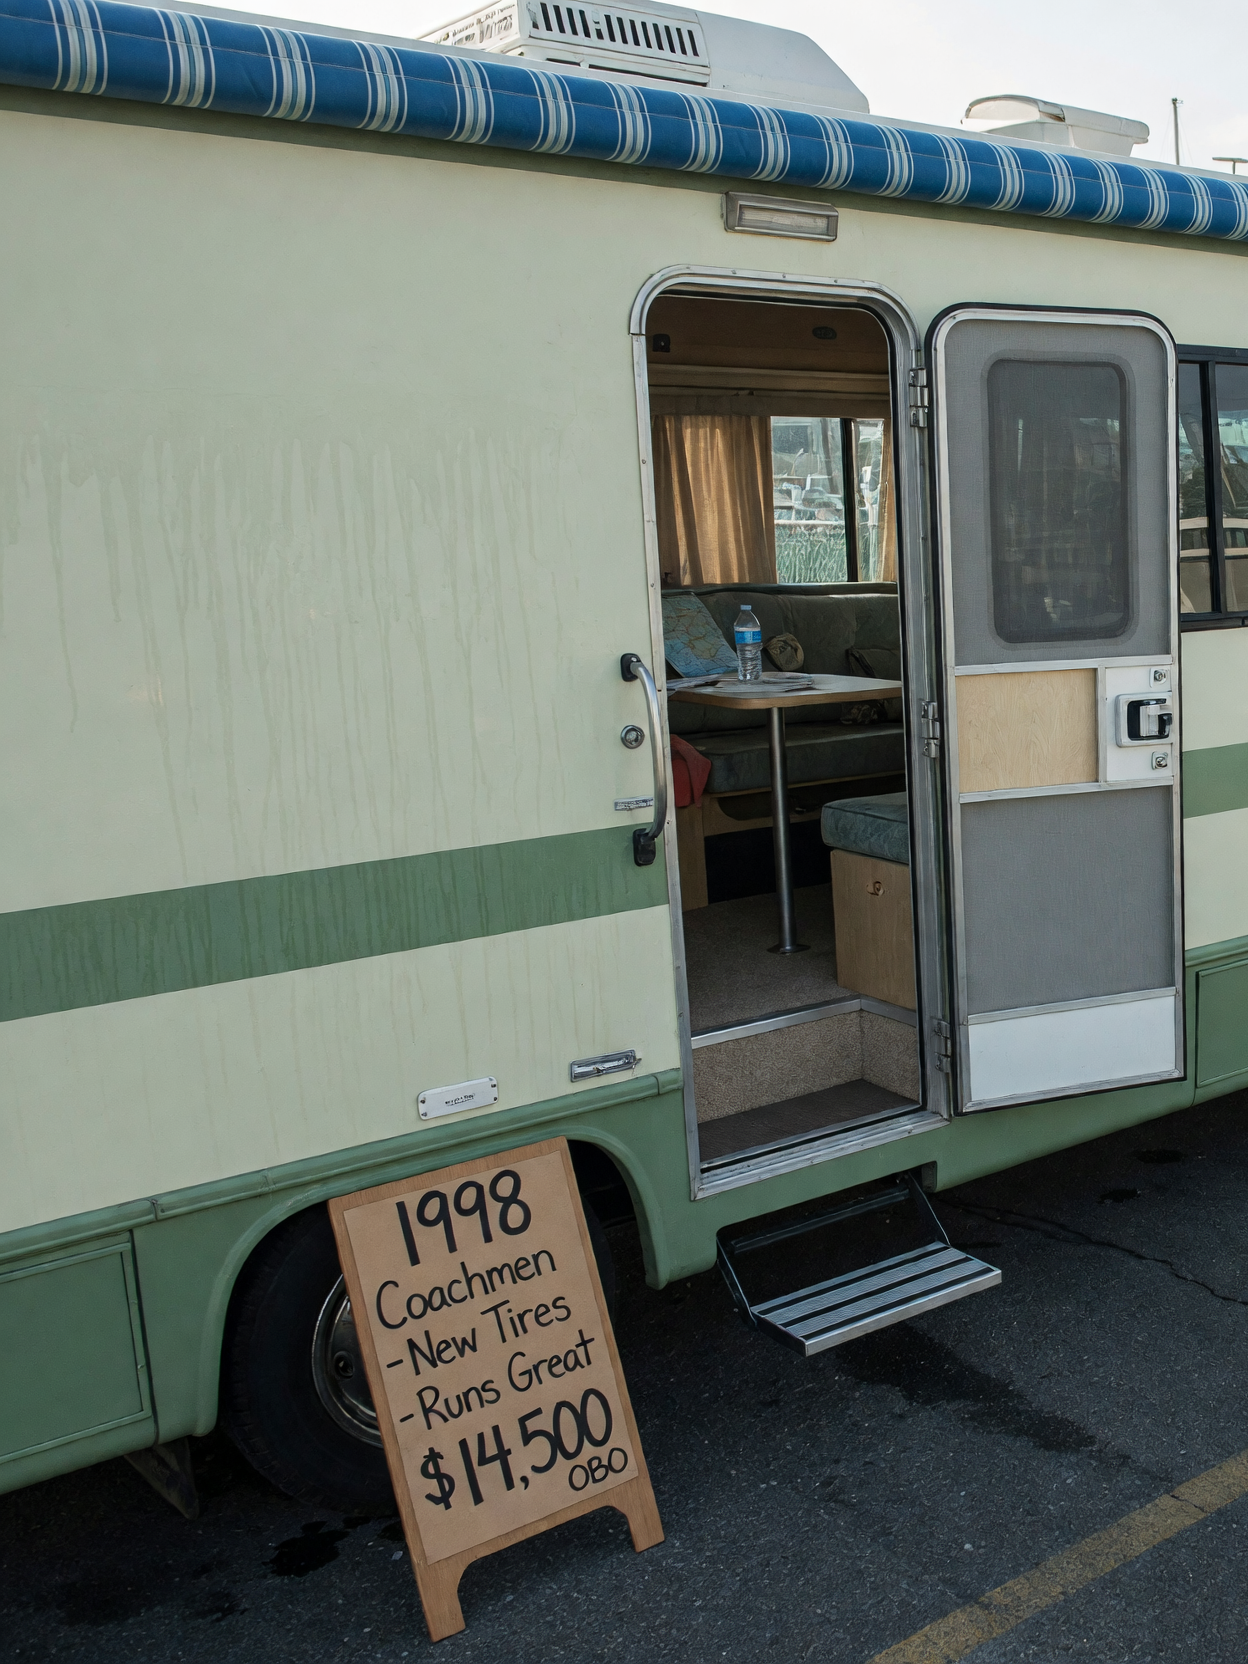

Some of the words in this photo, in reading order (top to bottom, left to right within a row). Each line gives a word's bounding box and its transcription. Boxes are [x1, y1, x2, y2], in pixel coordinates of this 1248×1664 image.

[396, 1169, 532, 1267] 1998
[376, 1250, 557, 1330] Coachmen
[481, 1295, 572, 1344] Tires
[507, 1329, 595, 1393] Great
[421, 1387, 613, 1511] $14,500
[568, 1447, 629, 1492] OBO
